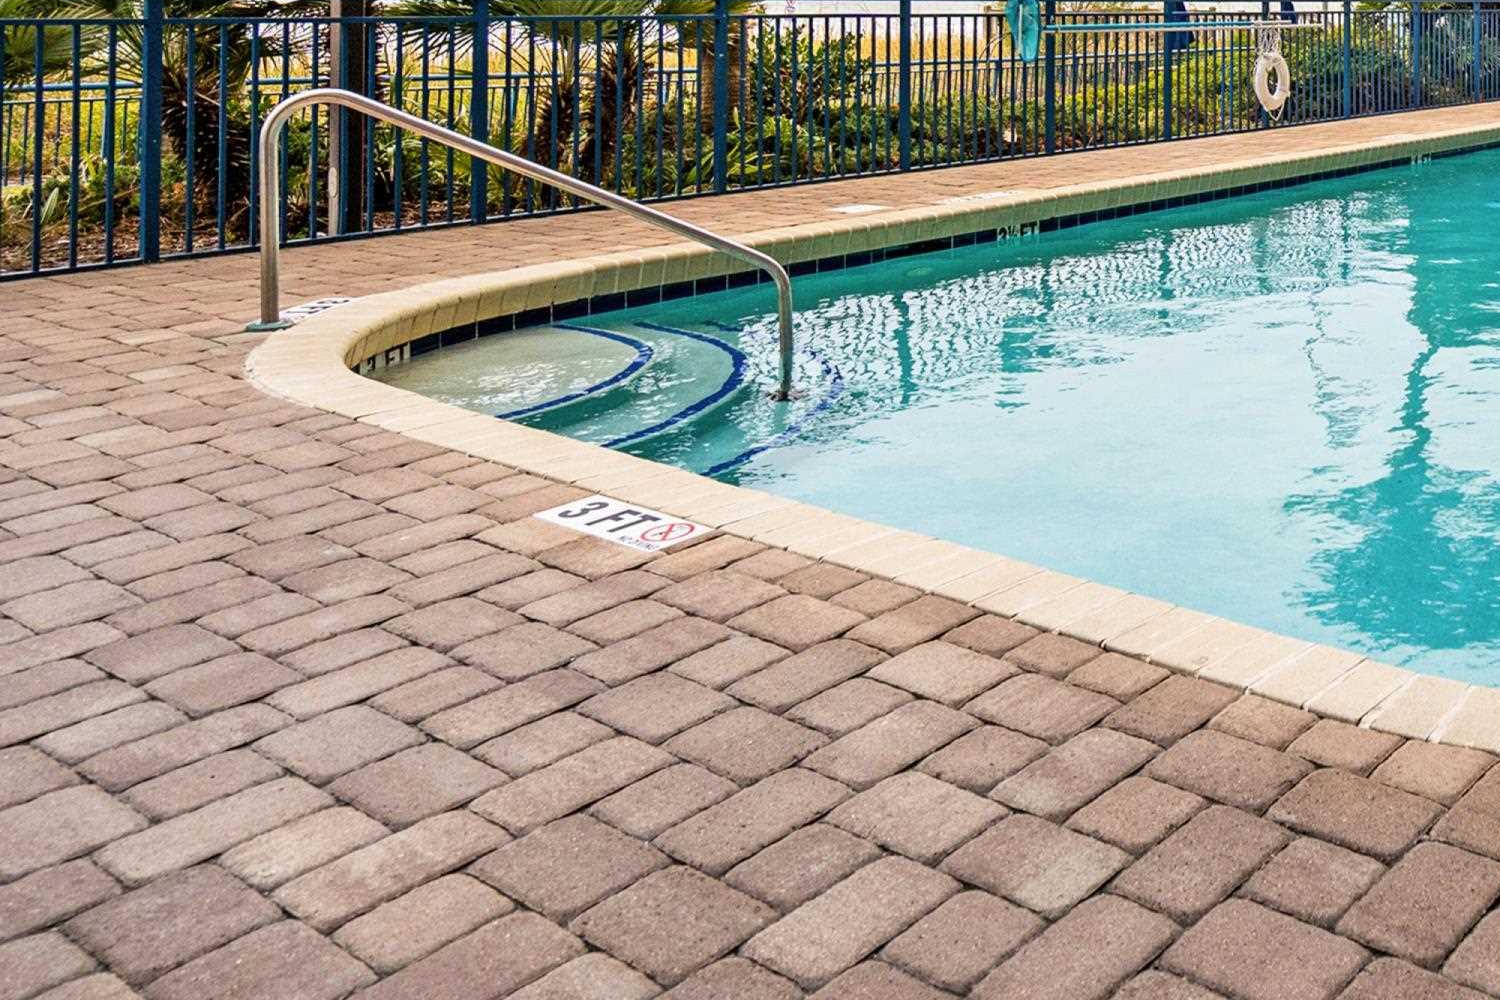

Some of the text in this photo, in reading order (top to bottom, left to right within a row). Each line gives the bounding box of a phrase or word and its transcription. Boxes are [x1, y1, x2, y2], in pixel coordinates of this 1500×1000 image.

[1020, 221, 1038, 236] FT
[558, 502, 662, 533] 3 FT
